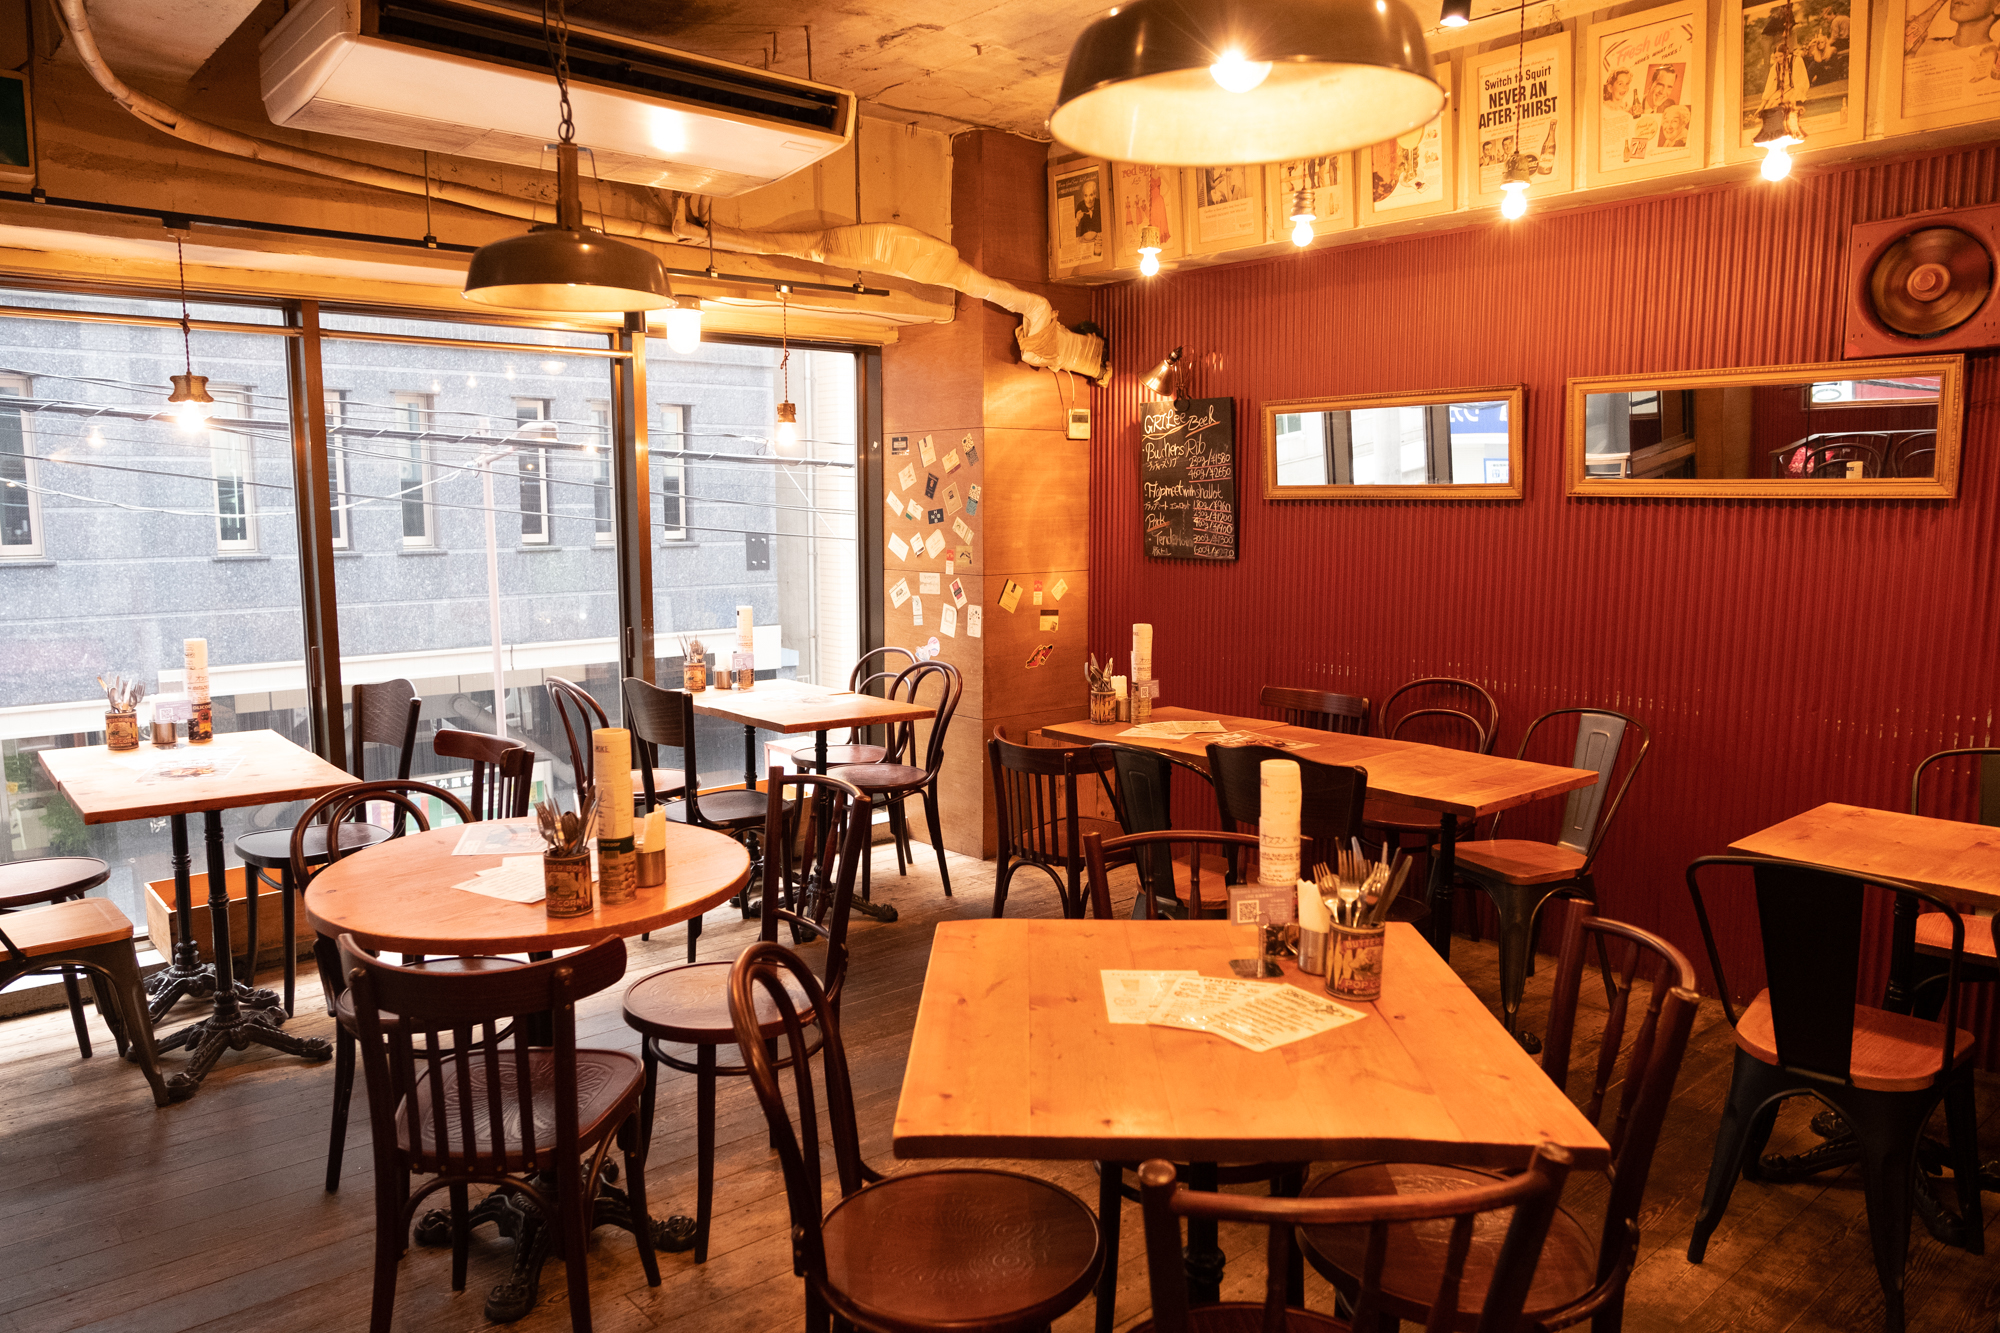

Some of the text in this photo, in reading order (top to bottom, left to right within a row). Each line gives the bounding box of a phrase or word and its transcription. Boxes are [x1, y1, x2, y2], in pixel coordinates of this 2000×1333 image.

[1616, 30, 1671, 66] Fresh up
[1484, 75, 1512, 91] Switch
[1515, 73, 1523, 84] to
[1525, 65, 1552, 82] Squirt
[1489, 80, 1548, 109] NEVER AN
[1122, 164, 1138, 178] red
[1184, 433, 1207, 458] Rib
[557, 898, 582, 907] CORN
[1345, 938, 1381, 949] BUTTER
[1345, 979, 1369, 989] POP
